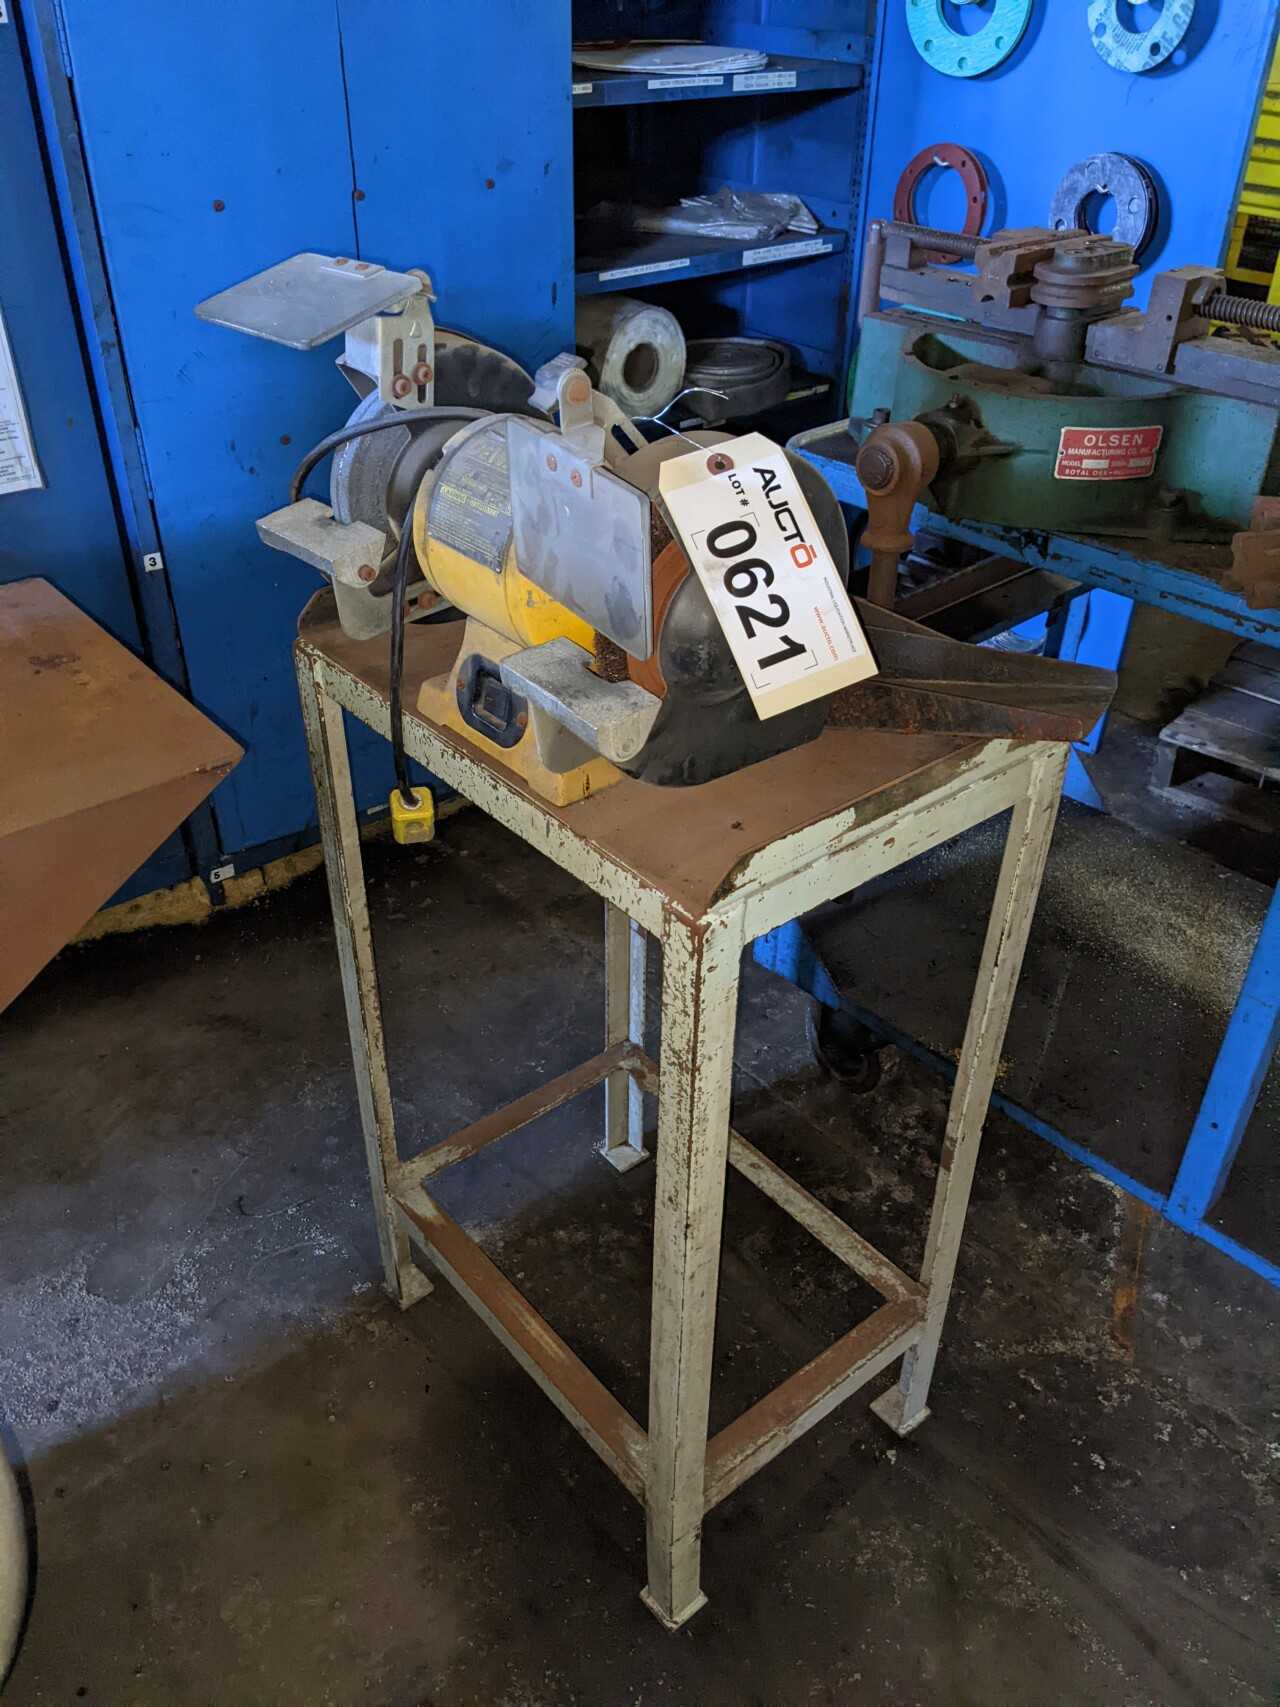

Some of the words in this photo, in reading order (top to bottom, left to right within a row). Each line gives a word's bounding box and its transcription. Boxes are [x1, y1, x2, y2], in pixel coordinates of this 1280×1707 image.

[1084, 434, 1144, 446] OLSEN
[727, 473, 745, 496] LOT
[739, 498, 750, 508] #
[148, 556, 157, 567] 3
[706, 519, 807, 670] 0621
